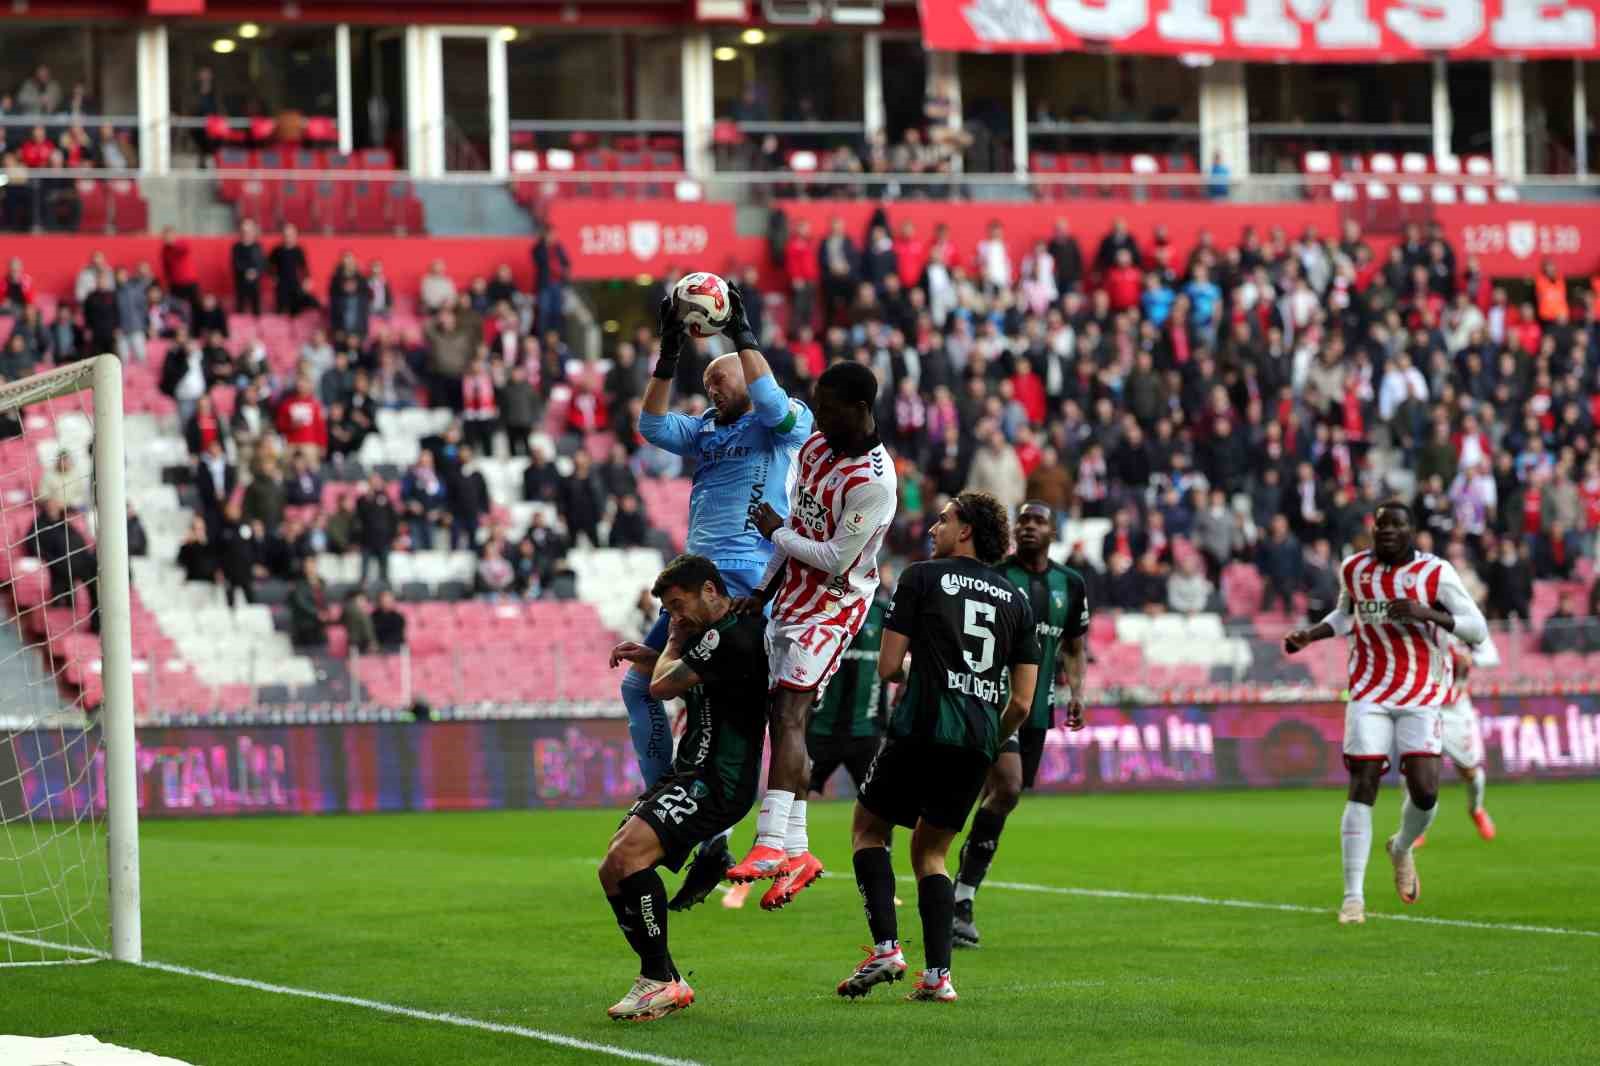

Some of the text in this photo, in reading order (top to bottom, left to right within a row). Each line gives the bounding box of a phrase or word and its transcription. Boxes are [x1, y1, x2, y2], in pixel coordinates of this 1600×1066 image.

[950, 573, 1013, 603] AUTOPORT
[799, 624, 833, 656] 47
[963, 598, 997, 674] 5
[946, 668, 999, 704] BALOGH
[657, 785, 698, 825] 22
